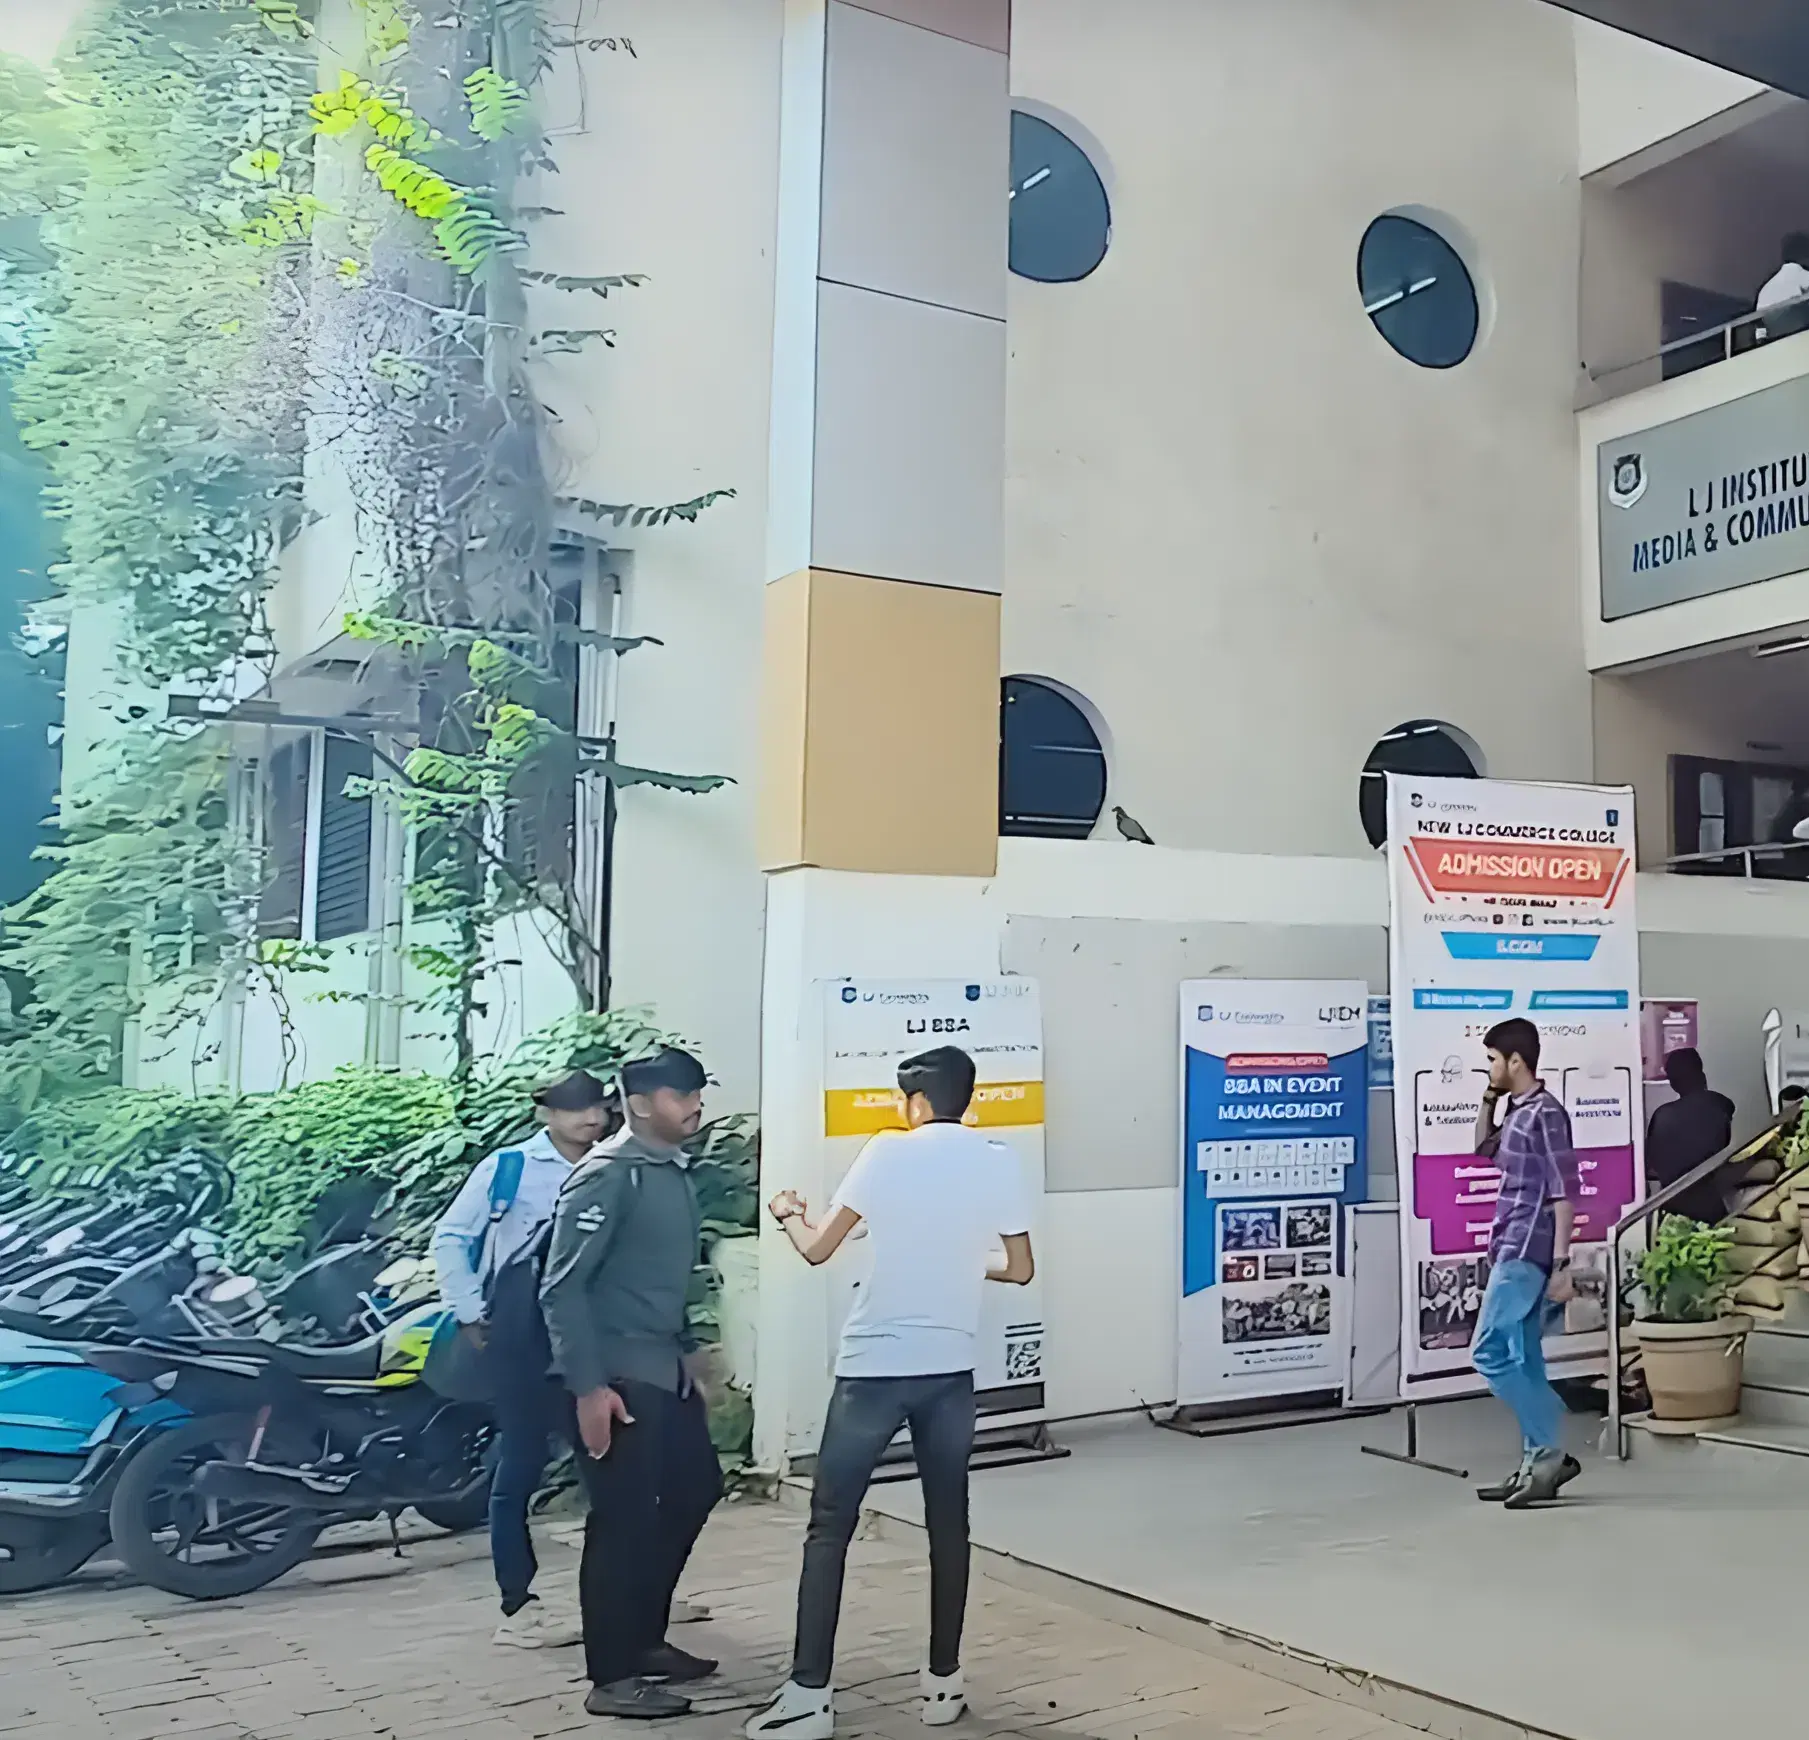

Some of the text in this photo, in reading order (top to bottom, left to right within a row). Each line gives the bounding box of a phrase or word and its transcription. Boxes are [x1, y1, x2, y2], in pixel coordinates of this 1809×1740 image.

[1688, 487, 1699, 518] L
[1704, 481, 1713, 515] J
[1632, 527, 1698, 573] MEDIA
[1704, 523, 1719, 554] &
[1438, 852, 1601, 881] ADMISSION OPEN
[1224, 1077, 1343, 1094] BBA IN EVENT
[1218, 1101, 1345, 1120] MANAGEMENT
